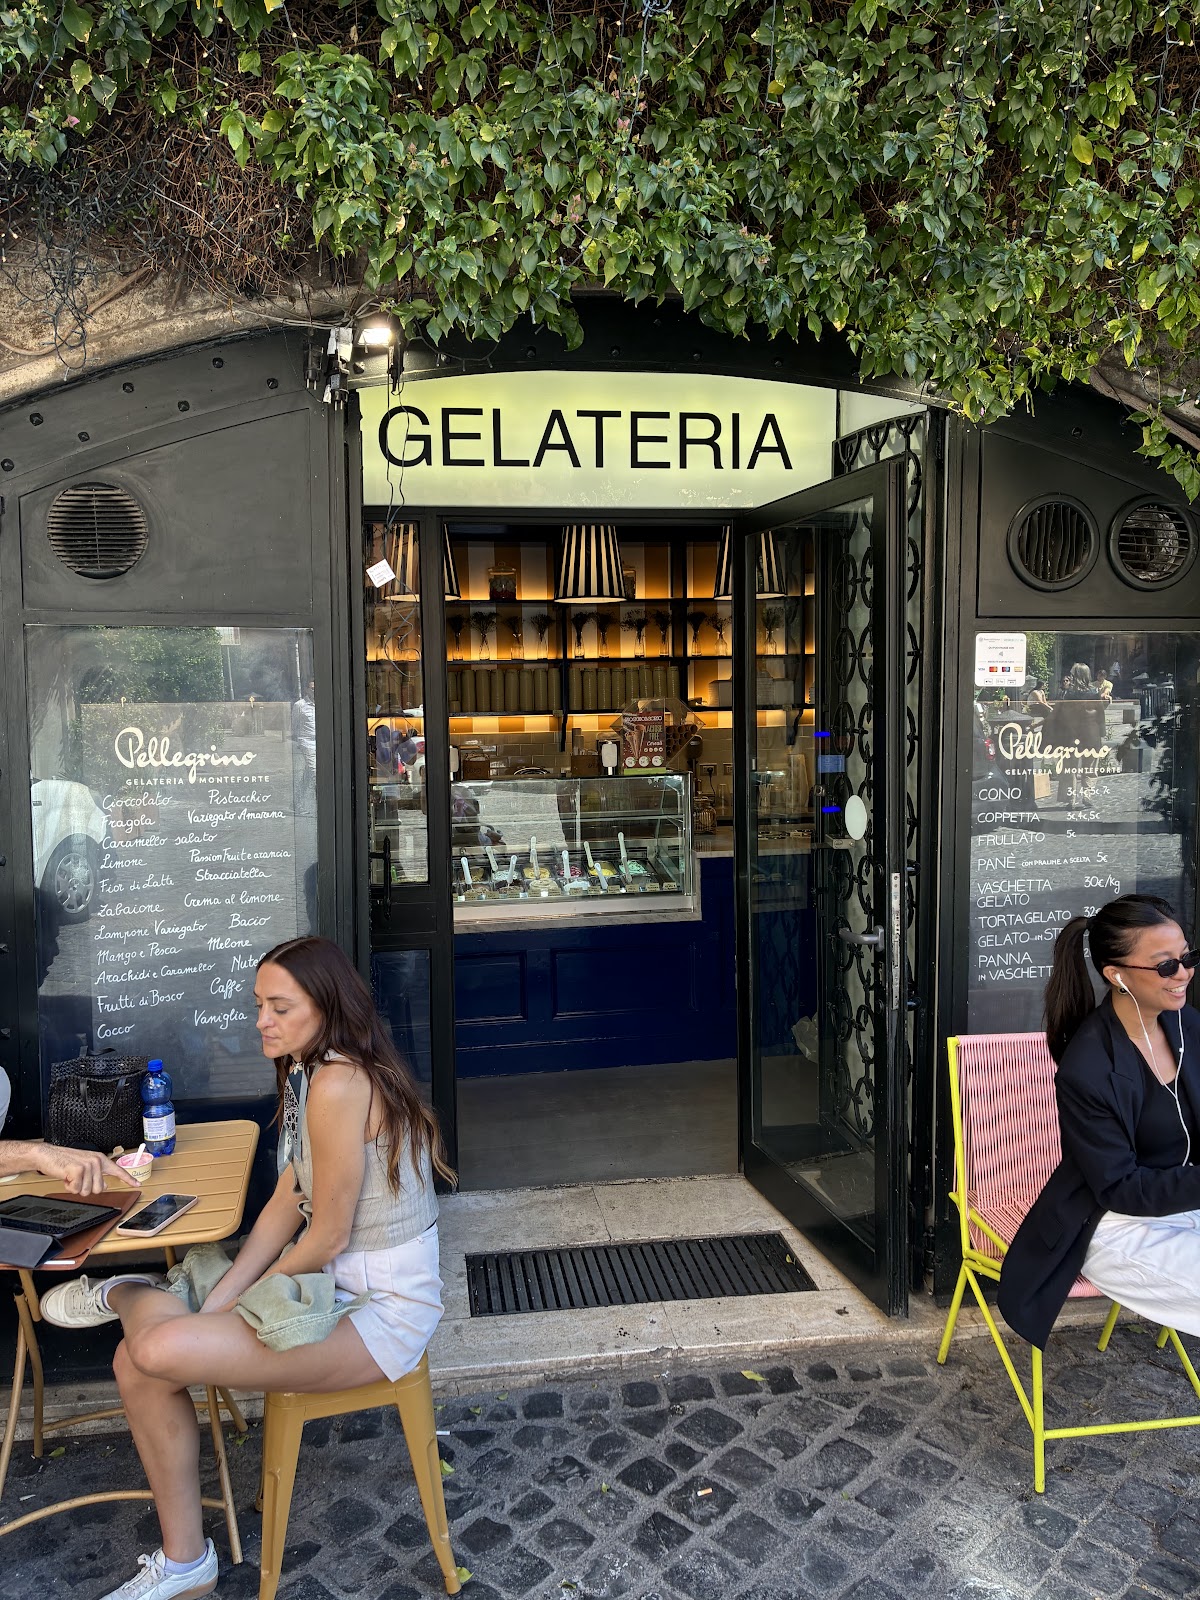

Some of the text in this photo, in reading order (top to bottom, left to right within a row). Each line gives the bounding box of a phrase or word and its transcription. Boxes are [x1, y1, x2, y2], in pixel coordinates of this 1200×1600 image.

[377, 405, 793, 471] GELATERIA
[114, 727, 257, 784] Pellegrino
[998, 722, 1112, 774] Pellegrino
[1005, 766, 1122, 776] GELATERIA MONTEFORTE
[126, 776, 270, 786] GELATERIA MONTEFORTE
[208, 790, 271, 805] Pistacchio
[978, 788, 1022, 800] CONO
[100, 814, 155, 833] Fragola
[188, 808, 286, 827] Variegato Amarena
[977, 812, 1040, 824] COPPETTA
[102, 832, 217, 850] Caramello salato
[978, 832, 1045, 846] FRULLATO
[100, 854, 147, 869] Limone
[254, 850, 291, 859] arancia
[978, 852, 1016, 871] PANÈ
[195, 867, 272, 881] Stracciatella
[99, 874, 174, 894] Fior di Latte
[977, 879, 1052, 894] VASCHETTA
[184, 891, 284, 908] Crema al limone
[976, 894, 1030, 908] GELATO
[97, 904, 164, 917] Zabaione
[228, 913, 271, 929] Bacio
[94, 920, 207, 944] Lampone Variegato
[978, 932, 1030, 947] GELATO
[207, 937, 252, 952] Melone
[97, 942, 183, 966] Mango e Pesca
[978, 952, 1033, 968] PANNA
[94, 969, 150, 985] Arachidi
[160, 963, 216, 977] Caramello
[97, 990, 184, 1013] Frutti di Bosco
[194, 1008, 247, 1030] Vaniglia
[97, 1023, 135, 1039] Cocco
